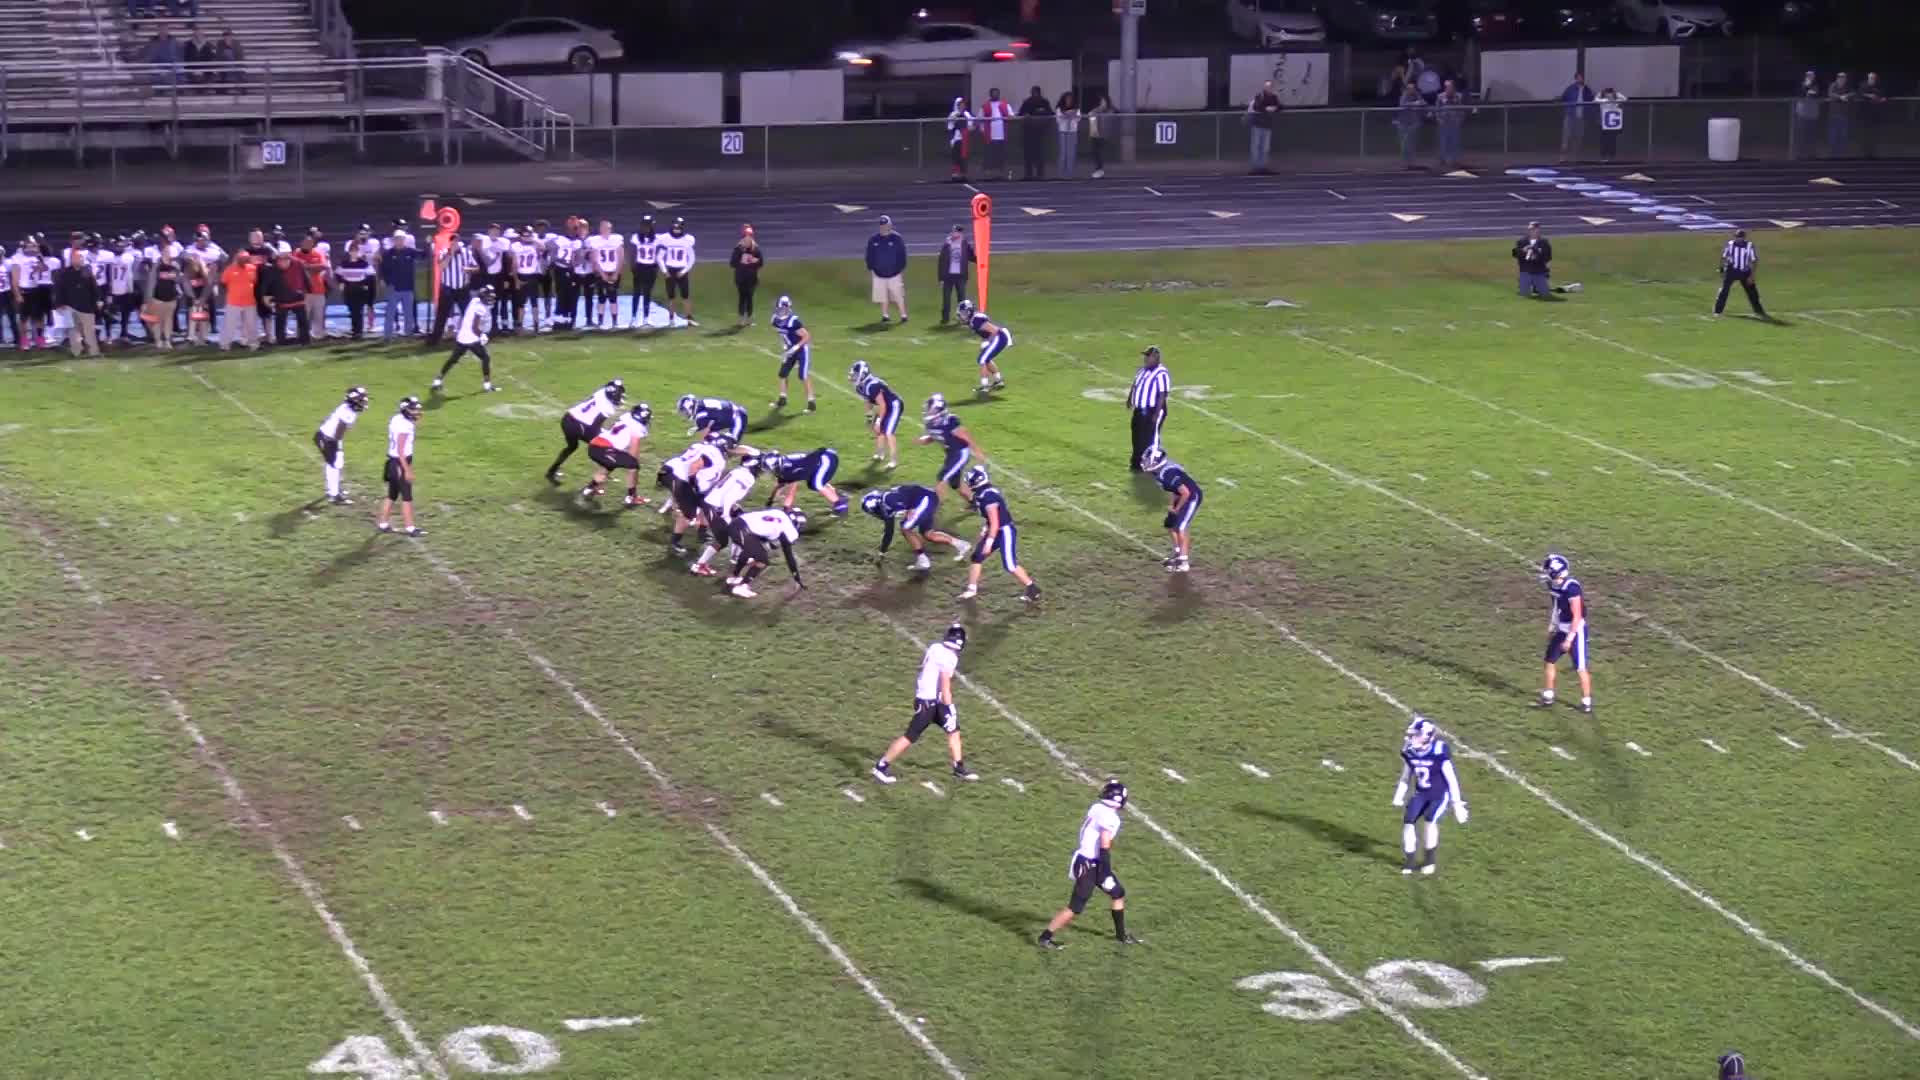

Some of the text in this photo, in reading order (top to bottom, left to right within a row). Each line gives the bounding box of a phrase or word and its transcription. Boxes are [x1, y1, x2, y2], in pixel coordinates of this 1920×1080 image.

[1604, 111, 1621, 128] G
[1159, 124, 1174, 142] 10
[264, 143, 283, 162] 30
[724, 135, 742, 153] 20
[1234, 960, 1488, 1020] 30
[307, 1025, 560, 1080] 40
